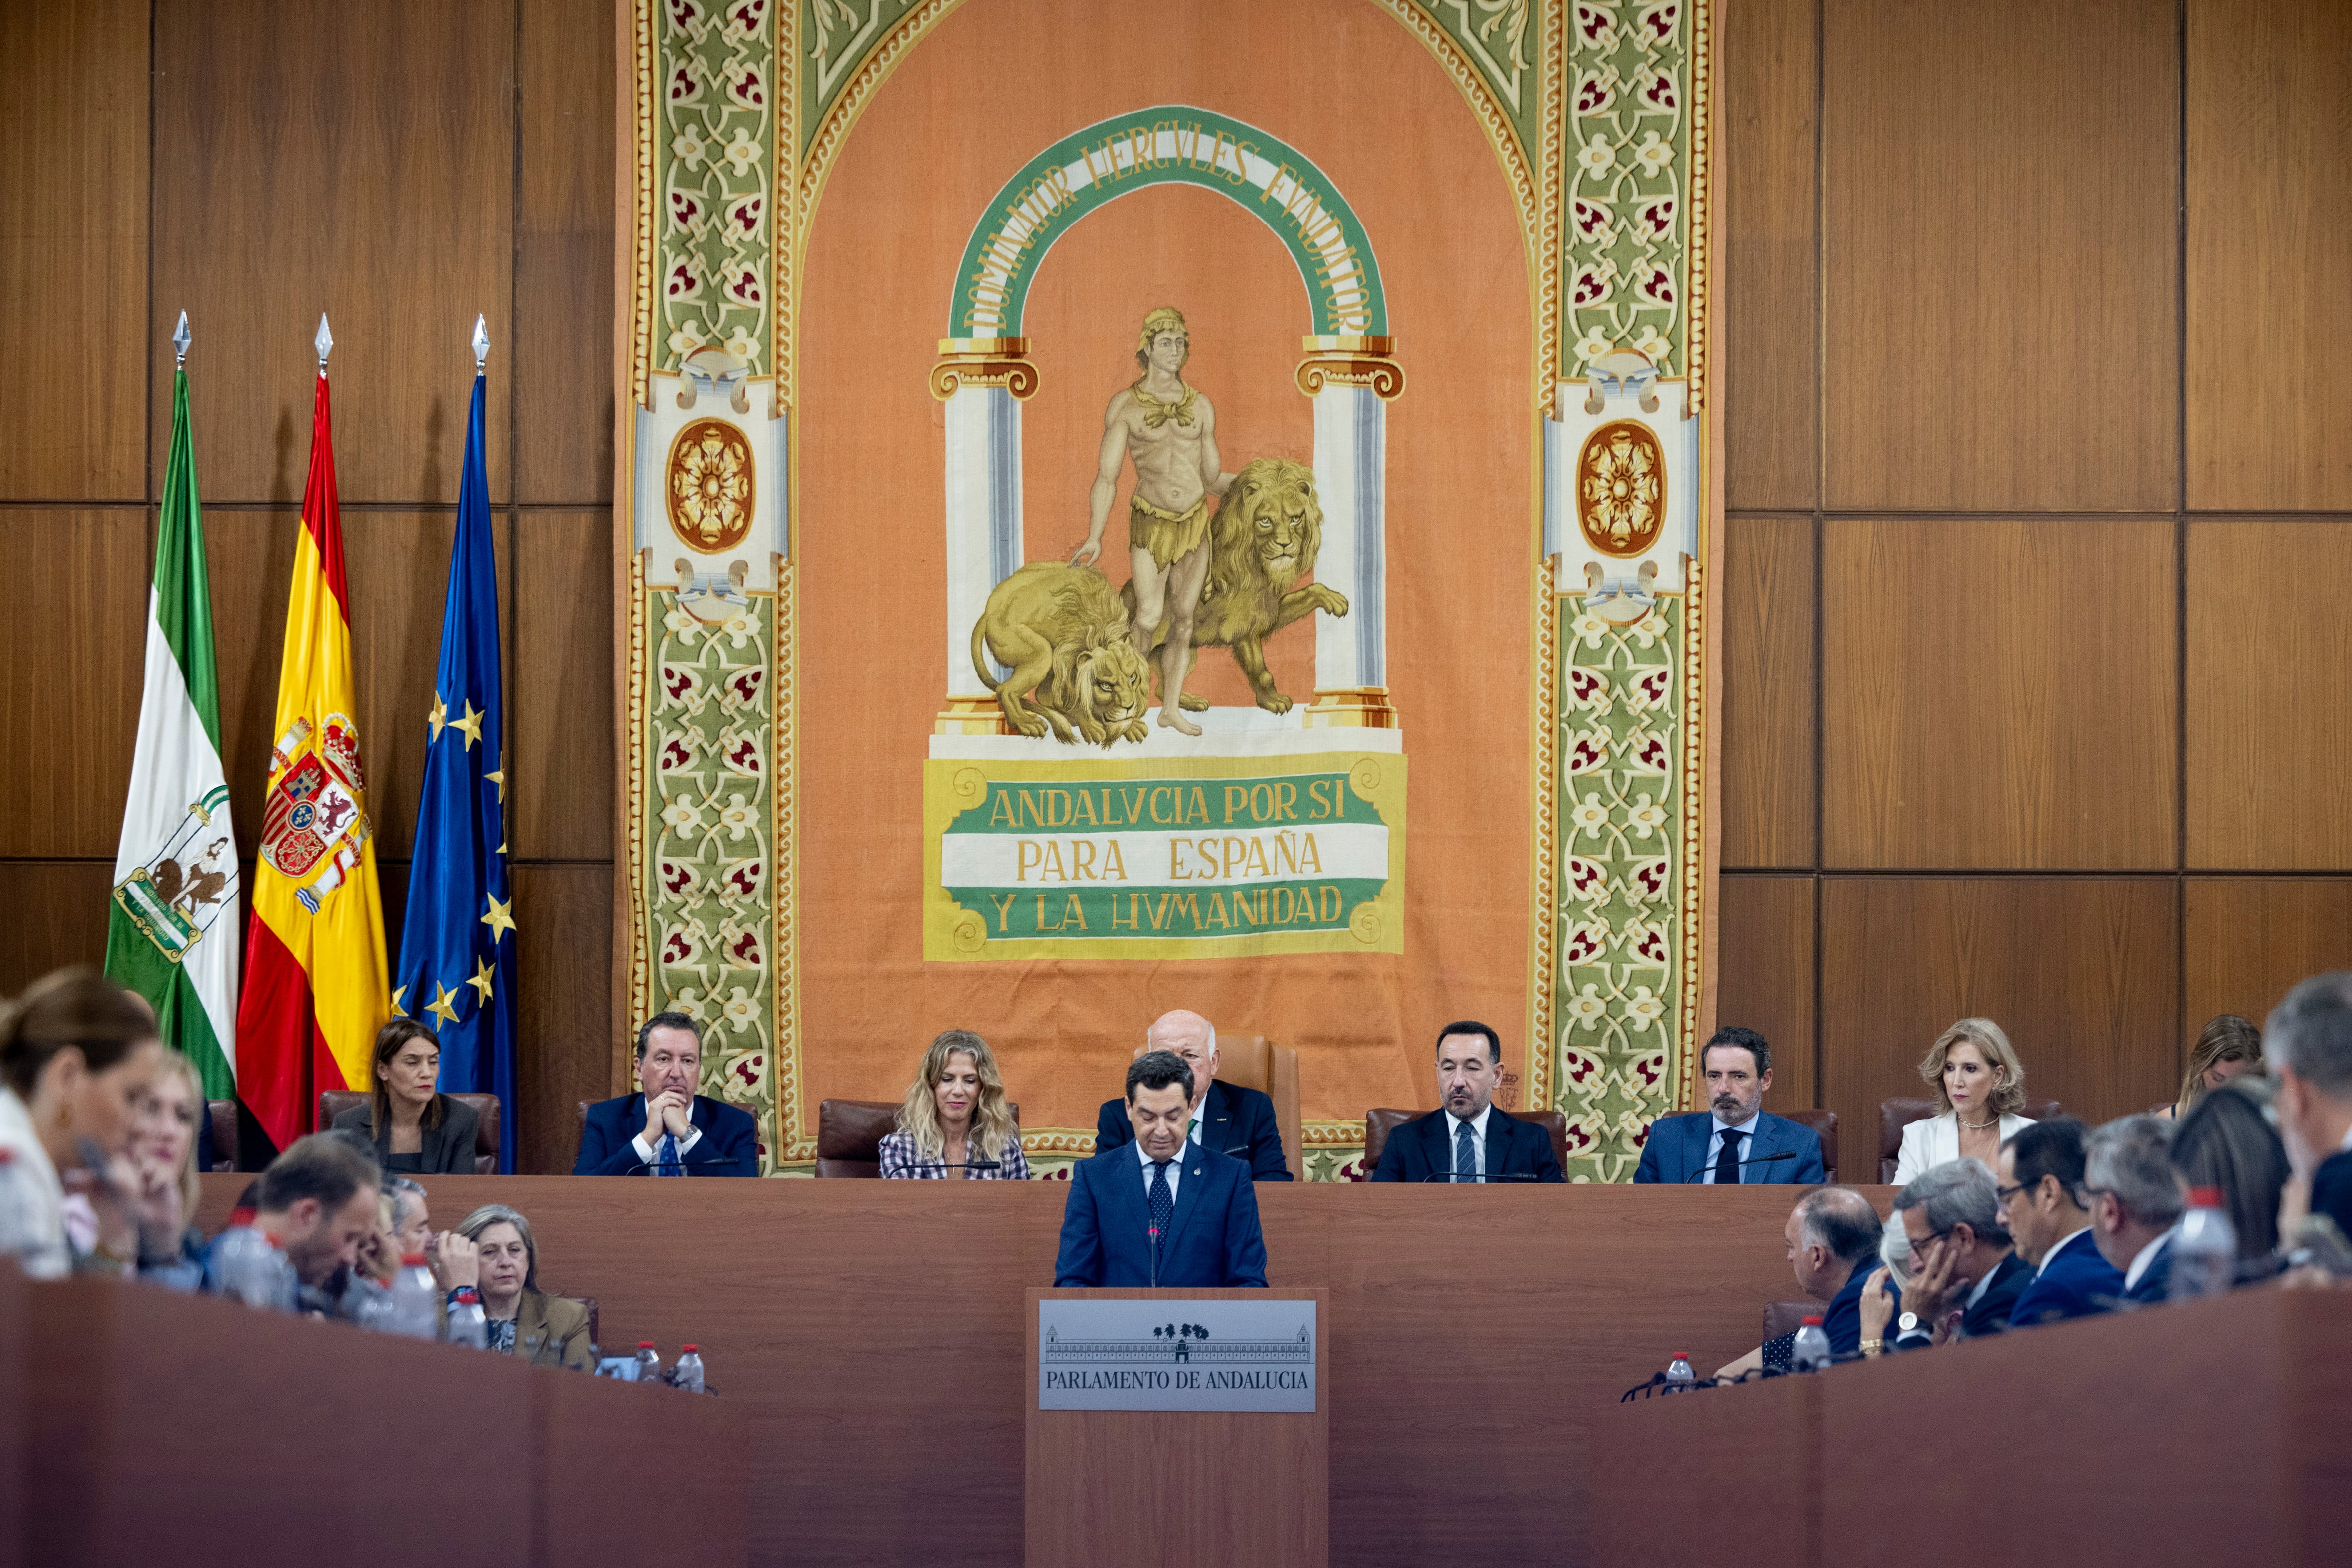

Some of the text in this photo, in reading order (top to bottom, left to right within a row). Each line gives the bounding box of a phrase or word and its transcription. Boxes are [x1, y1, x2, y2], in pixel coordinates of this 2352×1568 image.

[964, 120, 1373, 333] DOMINATOR HERCVLES FVNDATOR
[988, 779, 1345, 828] ANDALVCIA POR SI
[1016, 830, 1323, 882] PARA ESPAÑA
[989, 886, 1343, 931] Y LA HVMANIDAD
[1047, 1371, 1309, 1389] PARLAMENTO DE ANDALUCIA
